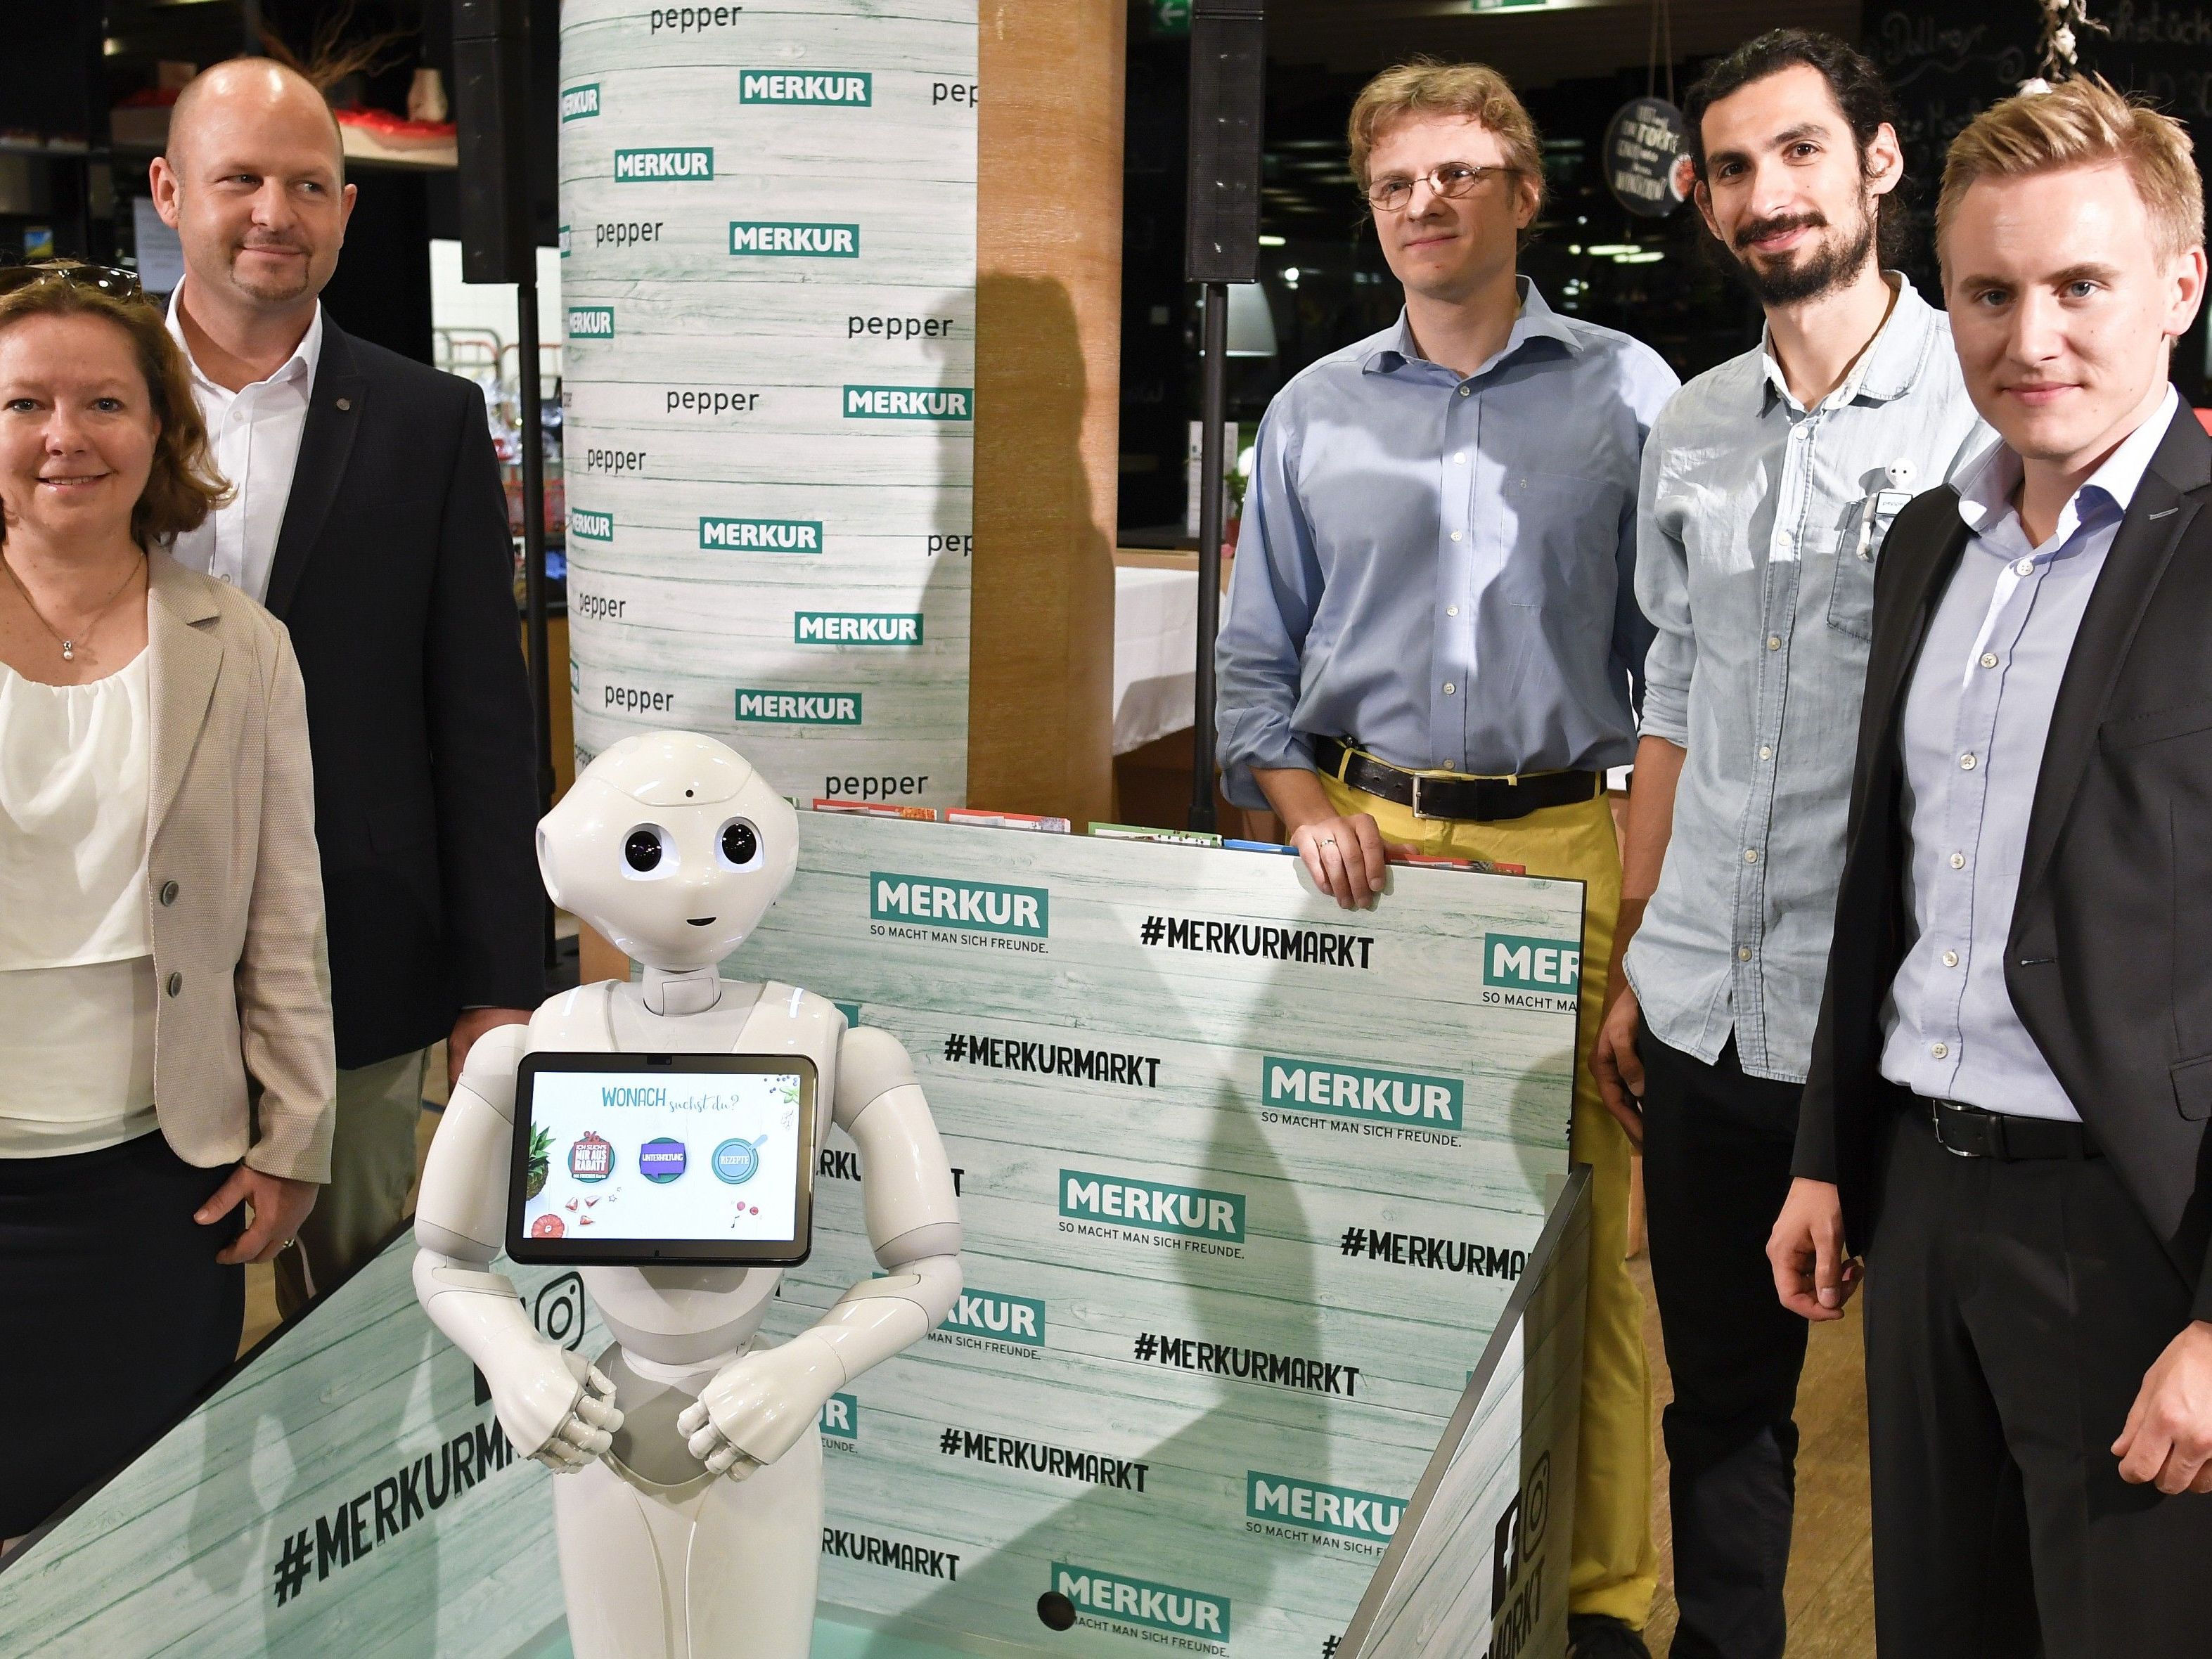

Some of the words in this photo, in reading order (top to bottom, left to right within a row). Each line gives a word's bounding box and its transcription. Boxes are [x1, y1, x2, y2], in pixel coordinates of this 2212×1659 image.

[650, 4, 742, 34] pepper
[745, 75, 866, 102] MERKUR
[617, 152, 709, 178] MERKUR
[596, 219, 664, 247] pepper
[734, 226, 854, 253] MERKUR
[848, 314, 954, 341] pepper
[667, 388, 760, 415] pepper
[849, 389, 967, 415] MERKUR
[587, 446, 646, 475] pepper
[704, 521, 817, 549] MERKUR
[579, 590, 626, 620] pepper
[799, 616, 917, 642] MERKUR
[605, 683, 674, 714] pepper
[740, 695, 856, 721] MERKUR
[825, 774, 928, 800] pepper
[877, 879, 1041, 929] MERKUR
[870, 924, 886, 936] SO
[889, 927, 928, 941] MACHT
[932, 931, 958, 945] MAN
[960, 934, 987, 948] SICH
[991, 937, 1049, 954] FREUNDE.
[1140, 915, 1374, 969] #MERKURMARKT
[1482, 991, 1500, 1003] SO
[1505, 993, 1552, 1009] MACHT
[944, 1033, 1161, 1088] #MERKURMARKT
[602, 1087, 667, 1106] WONACH
[1271, 1066, 1453, 1121] MERKUR
[1261, 1111, 1278, 1123] SO
[1282, 1116, 1327, 1130] MACHT
[1330, 1120, 1359, 1134] MAN
[1363, 1123, 1394, 1138] SICH
[1397, 1128, 1462, 1148] FREUNDE.
[574, 1160, 607, 1171] RABATT
[576, 1149, 591, 1161] MIR
[591, 1149, 607, 1161] AUS
[642, 1153, 683, 1162] UNTERHALTUNG
[721, 1155, 750, 1165] REZEPTE
[1067, 1177, 1237, 1234] MERKUR
[1059, 1222, 1075, 1233] SO
[1078, 1225, 1119, 1241] MACHT
[1124, 1231, 1150, 1245] MAN
[1154, 1235, 1181, 1250] SICH
[1185, 1239, 1245, 1260] FREUNDE.
[1341, 1226, 1532, 1282] #MERKURMA
[927, 1332, 952, 1344] MAN
[956, 1336, 982, 1350] SICH
[985, 1341, 1041, 1360] FREUNDE.
[1134, 1331, 1360, 1396] #MERKURMARKT
[940, 1428, 1149, 1492] #MERKURMARKT
[1254, 1480, 1407, 1535] MERKU
[1246, 1522, 1262, 1533] SO
[1266, 1525, 1308, 1543] MACHT
[1313, 1534, 1340, 1549] MAN
[1344, 1539, 1373, 1555] SICH
[1112, 1624, 1138, 1638] MAN
[1142, 1631, 1169, 1645] SICH
[1172, 1637, 1230, 1658] FREUNDE.
